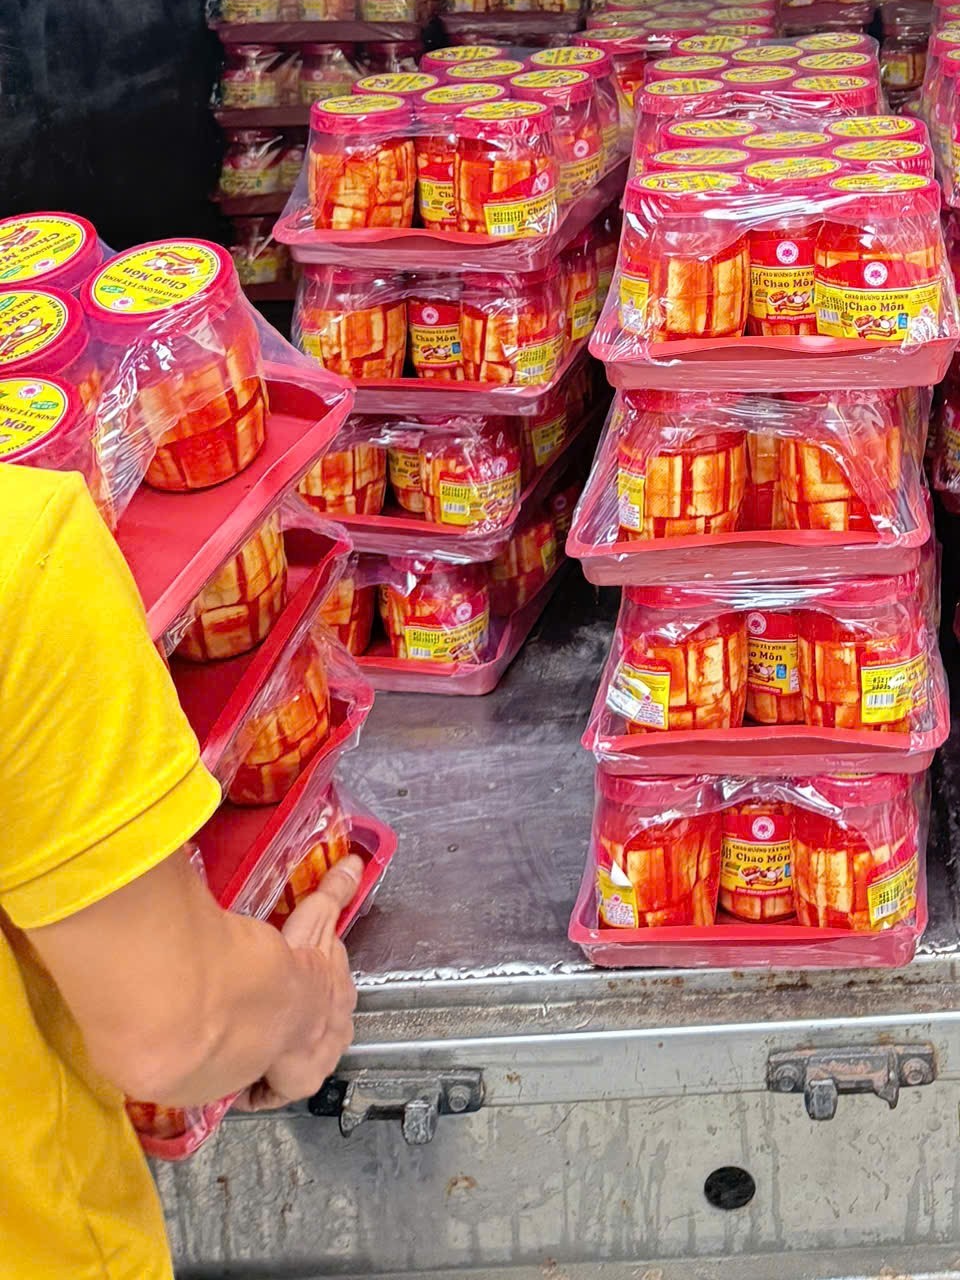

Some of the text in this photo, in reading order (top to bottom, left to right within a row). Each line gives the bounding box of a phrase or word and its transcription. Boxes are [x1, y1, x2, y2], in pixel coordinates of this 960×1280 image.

[122, 267, 187, 290] Chao Môn
[764, 279, 789, 288] Chao
[848, 301, 877, 312] Chao
[880, 302, 904, 312] Môn
[0, 417, 35, 432] Môn
[760, 651, 782, 661] Môn
[736, 852, 791, 863] Chao Môn
